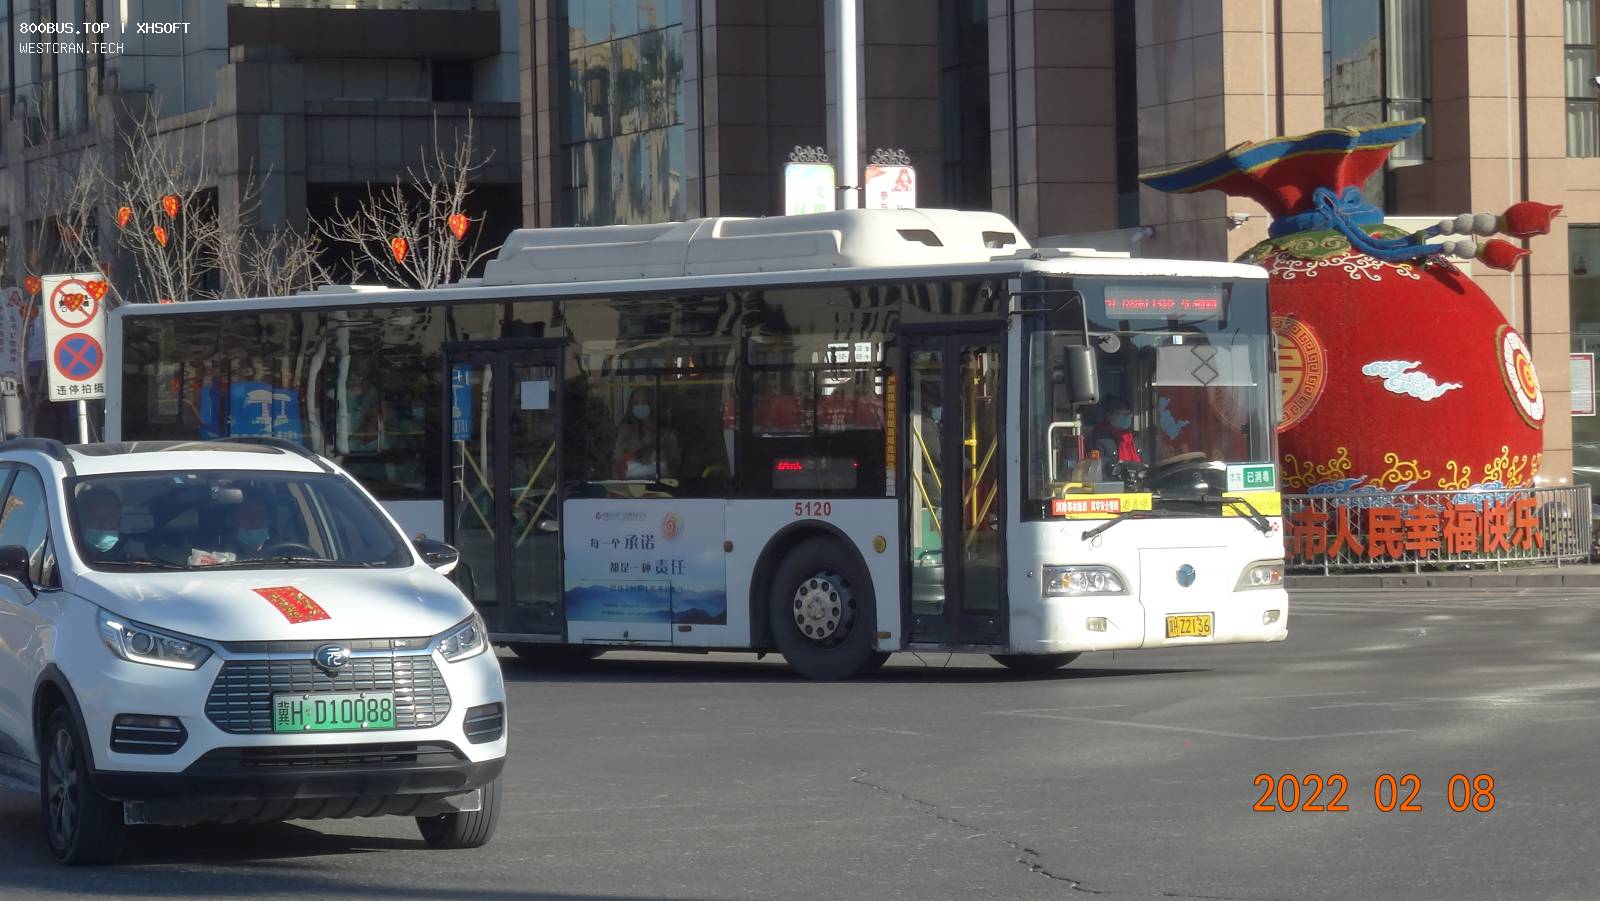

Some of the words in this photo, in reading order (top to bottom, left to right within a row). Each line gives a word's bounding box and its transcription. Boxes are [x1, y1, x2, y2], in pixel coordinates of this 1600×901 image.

[56, 382, 104, 396] 违停拍摄
[794, 501, 832, 517] 5120
[1284, 497, 1545, 561] 市人民幸福快乐
